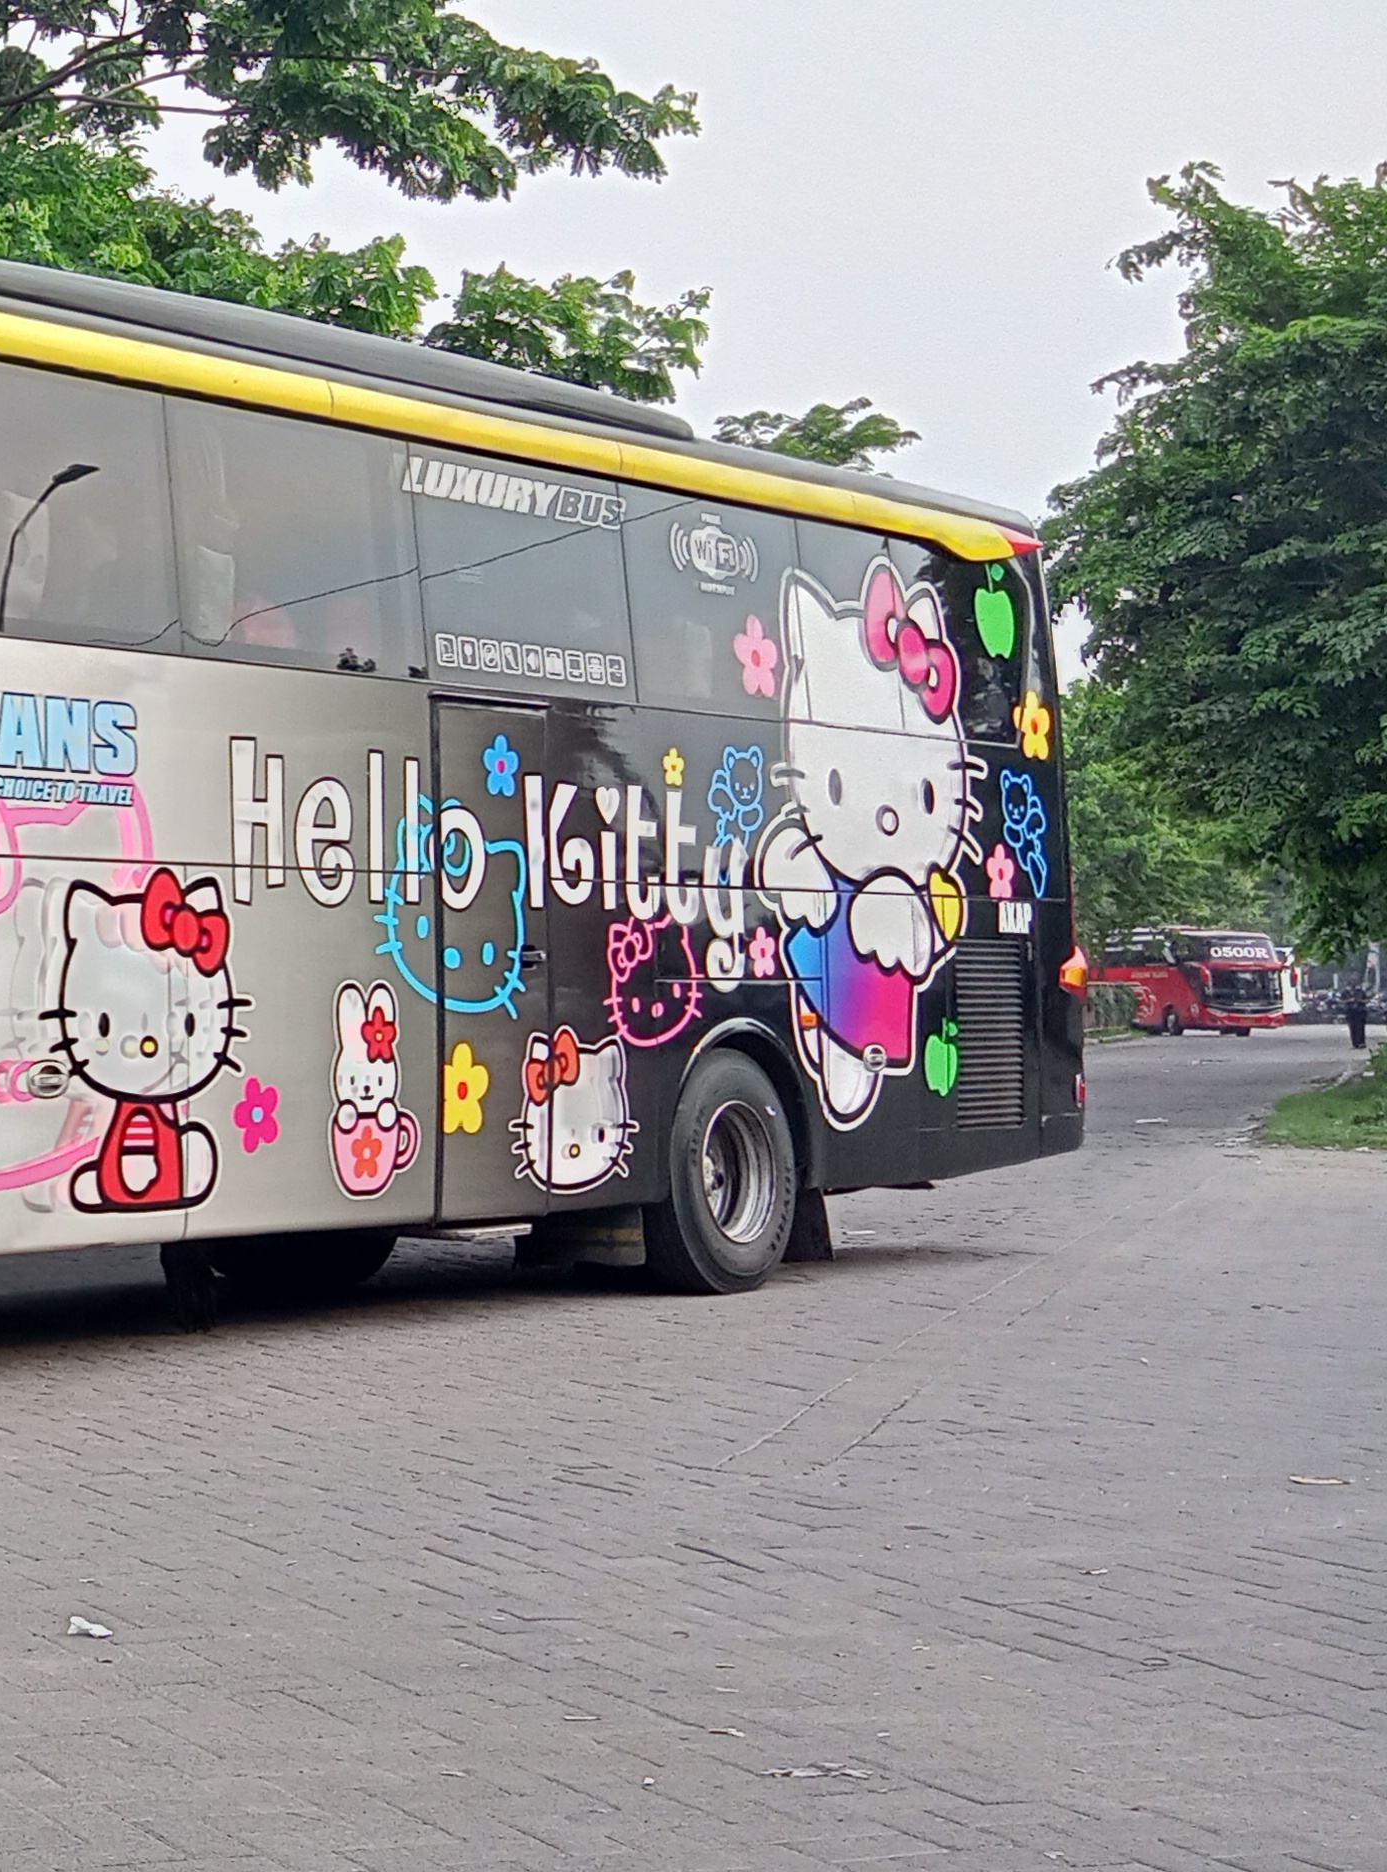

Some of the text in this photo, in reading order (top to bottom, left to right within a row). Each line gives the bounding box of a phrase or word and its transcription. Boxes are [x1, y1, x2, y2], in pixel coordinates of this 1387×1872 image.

[402, 456, 627, 529] LUXURY BUS
[54, 779, 75, 803] TO
[76, 781, 135, 806] TRAVEL
[229, 736, 749, 992] Hello Kitty
[998, 900, 1032, 934] AKAP
